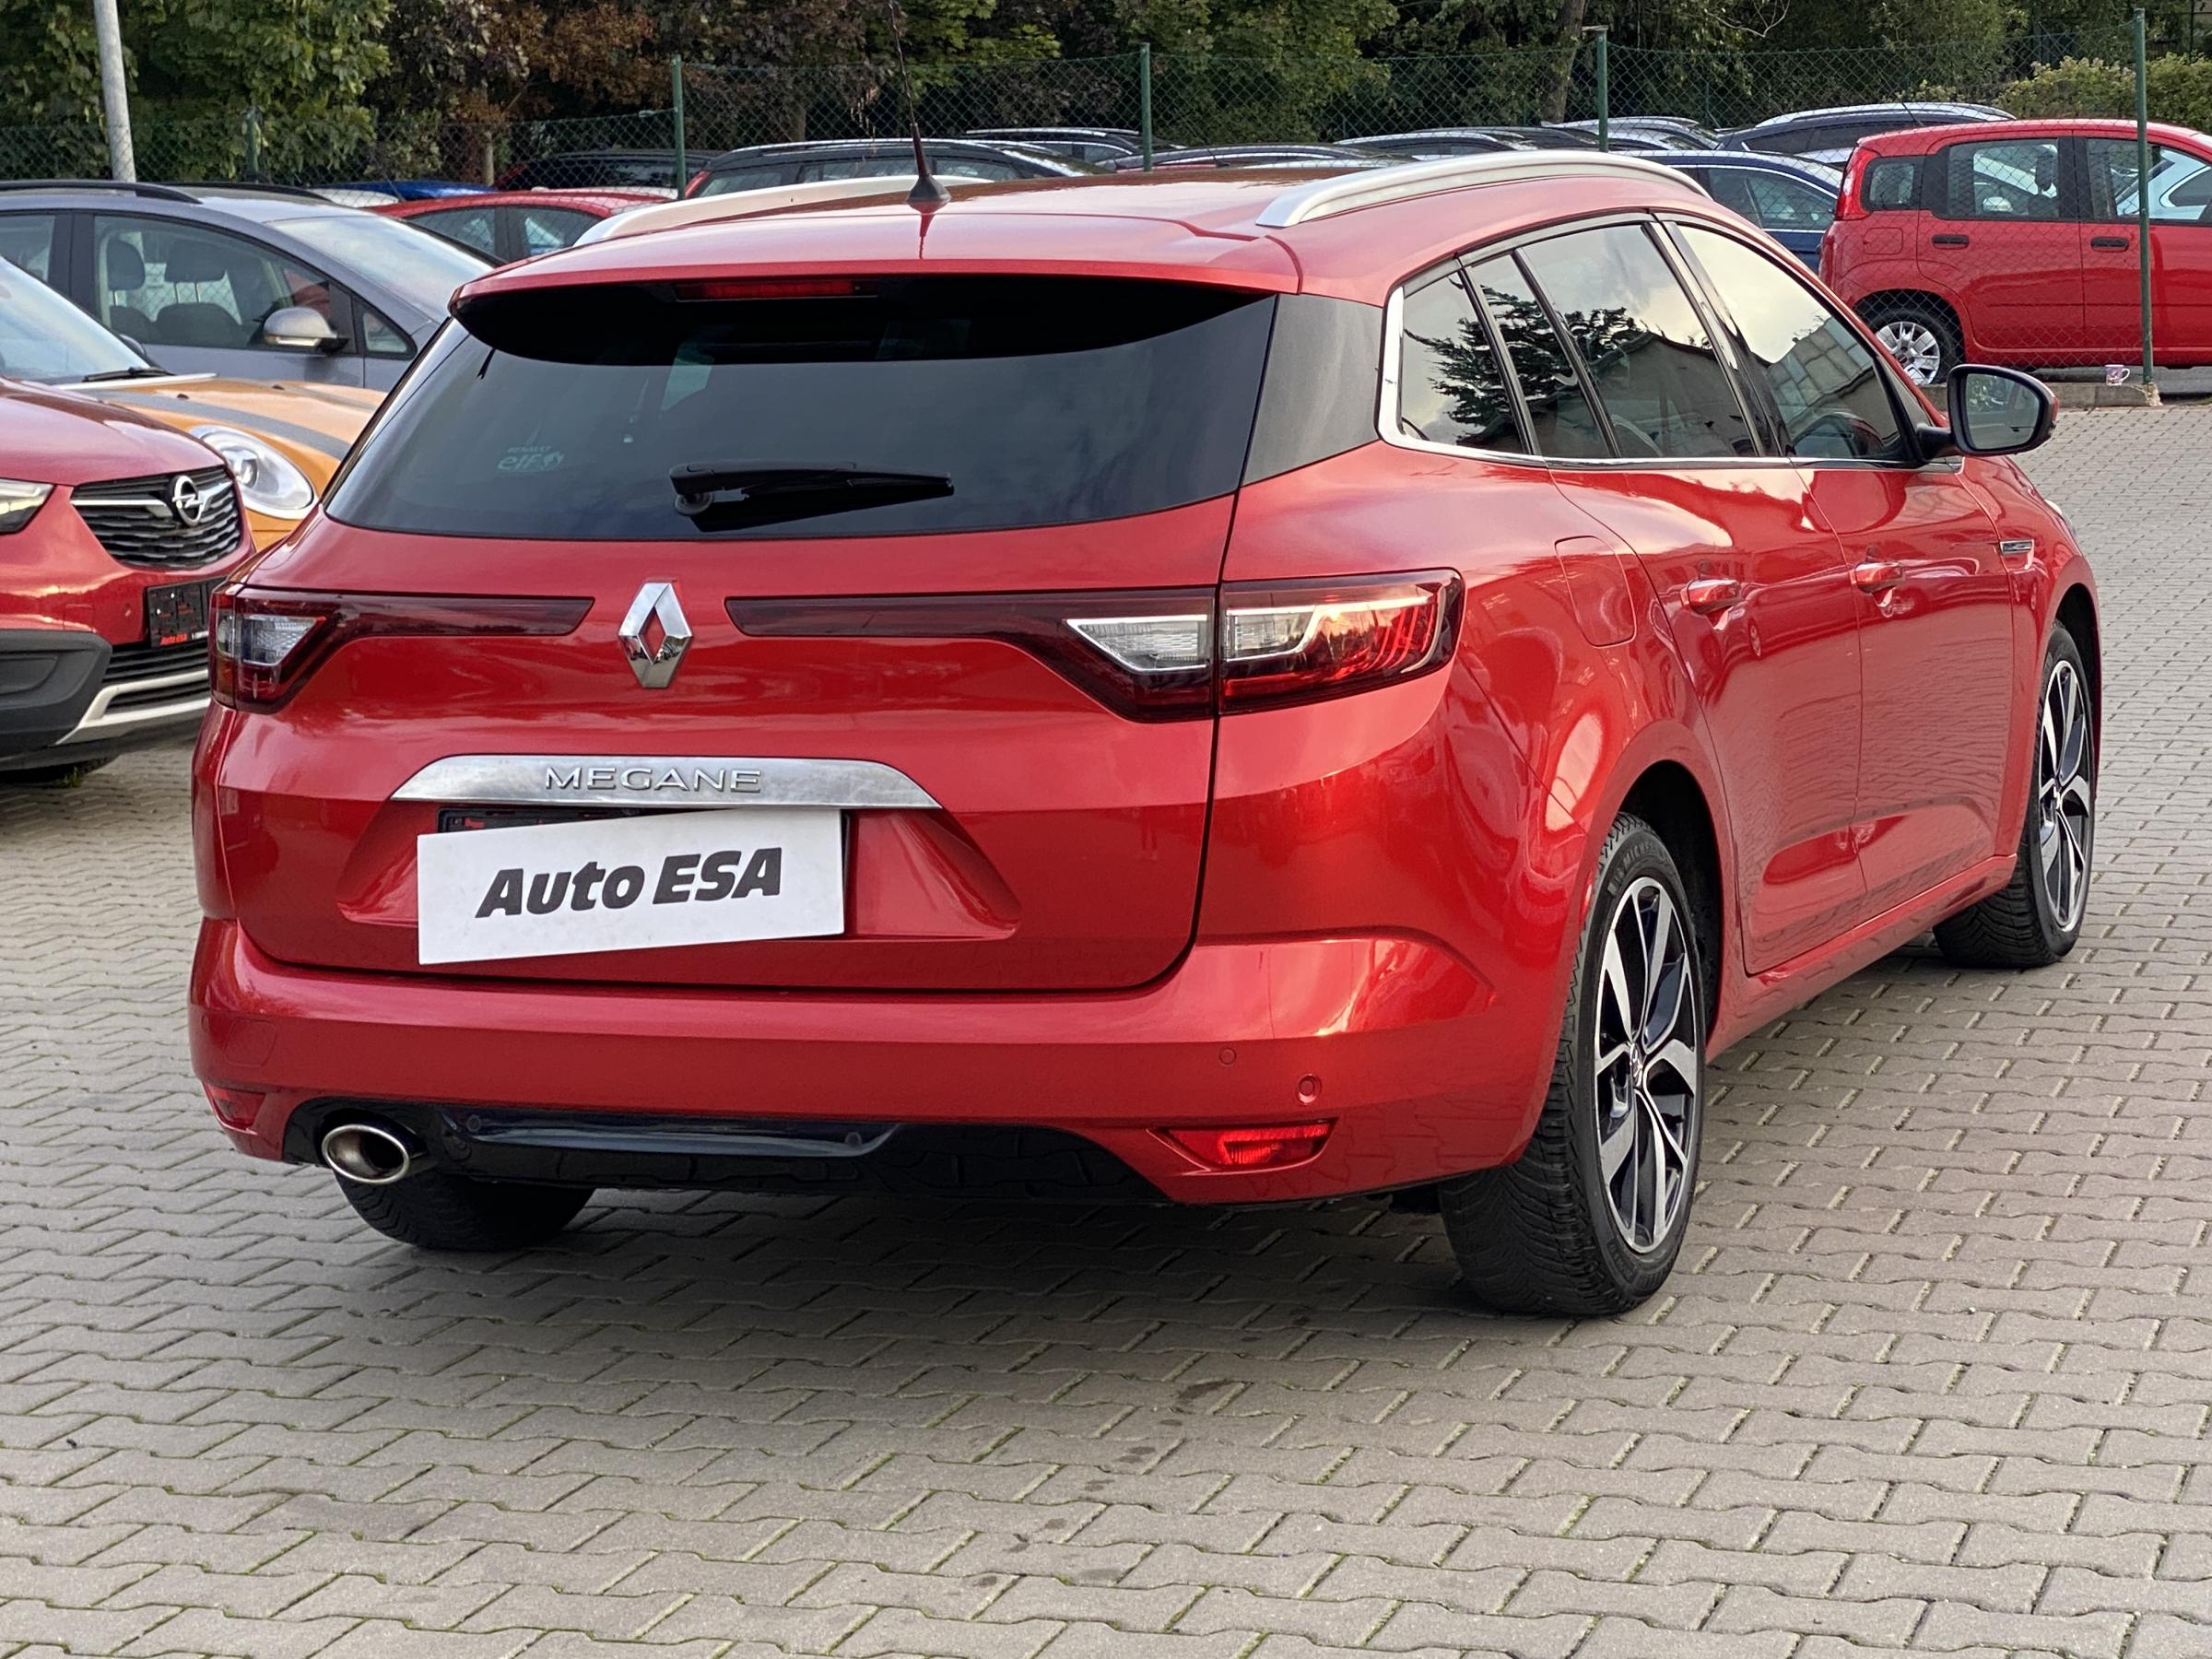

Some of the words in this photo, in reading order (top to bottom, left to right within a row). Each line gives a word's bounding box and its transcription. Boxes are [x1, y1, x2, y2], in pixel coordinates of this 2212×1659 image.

[546, 767, 760, 793] MEGANE
[475, 861, 645, 918] Auto
[653, 847, 782, 904] ESA
